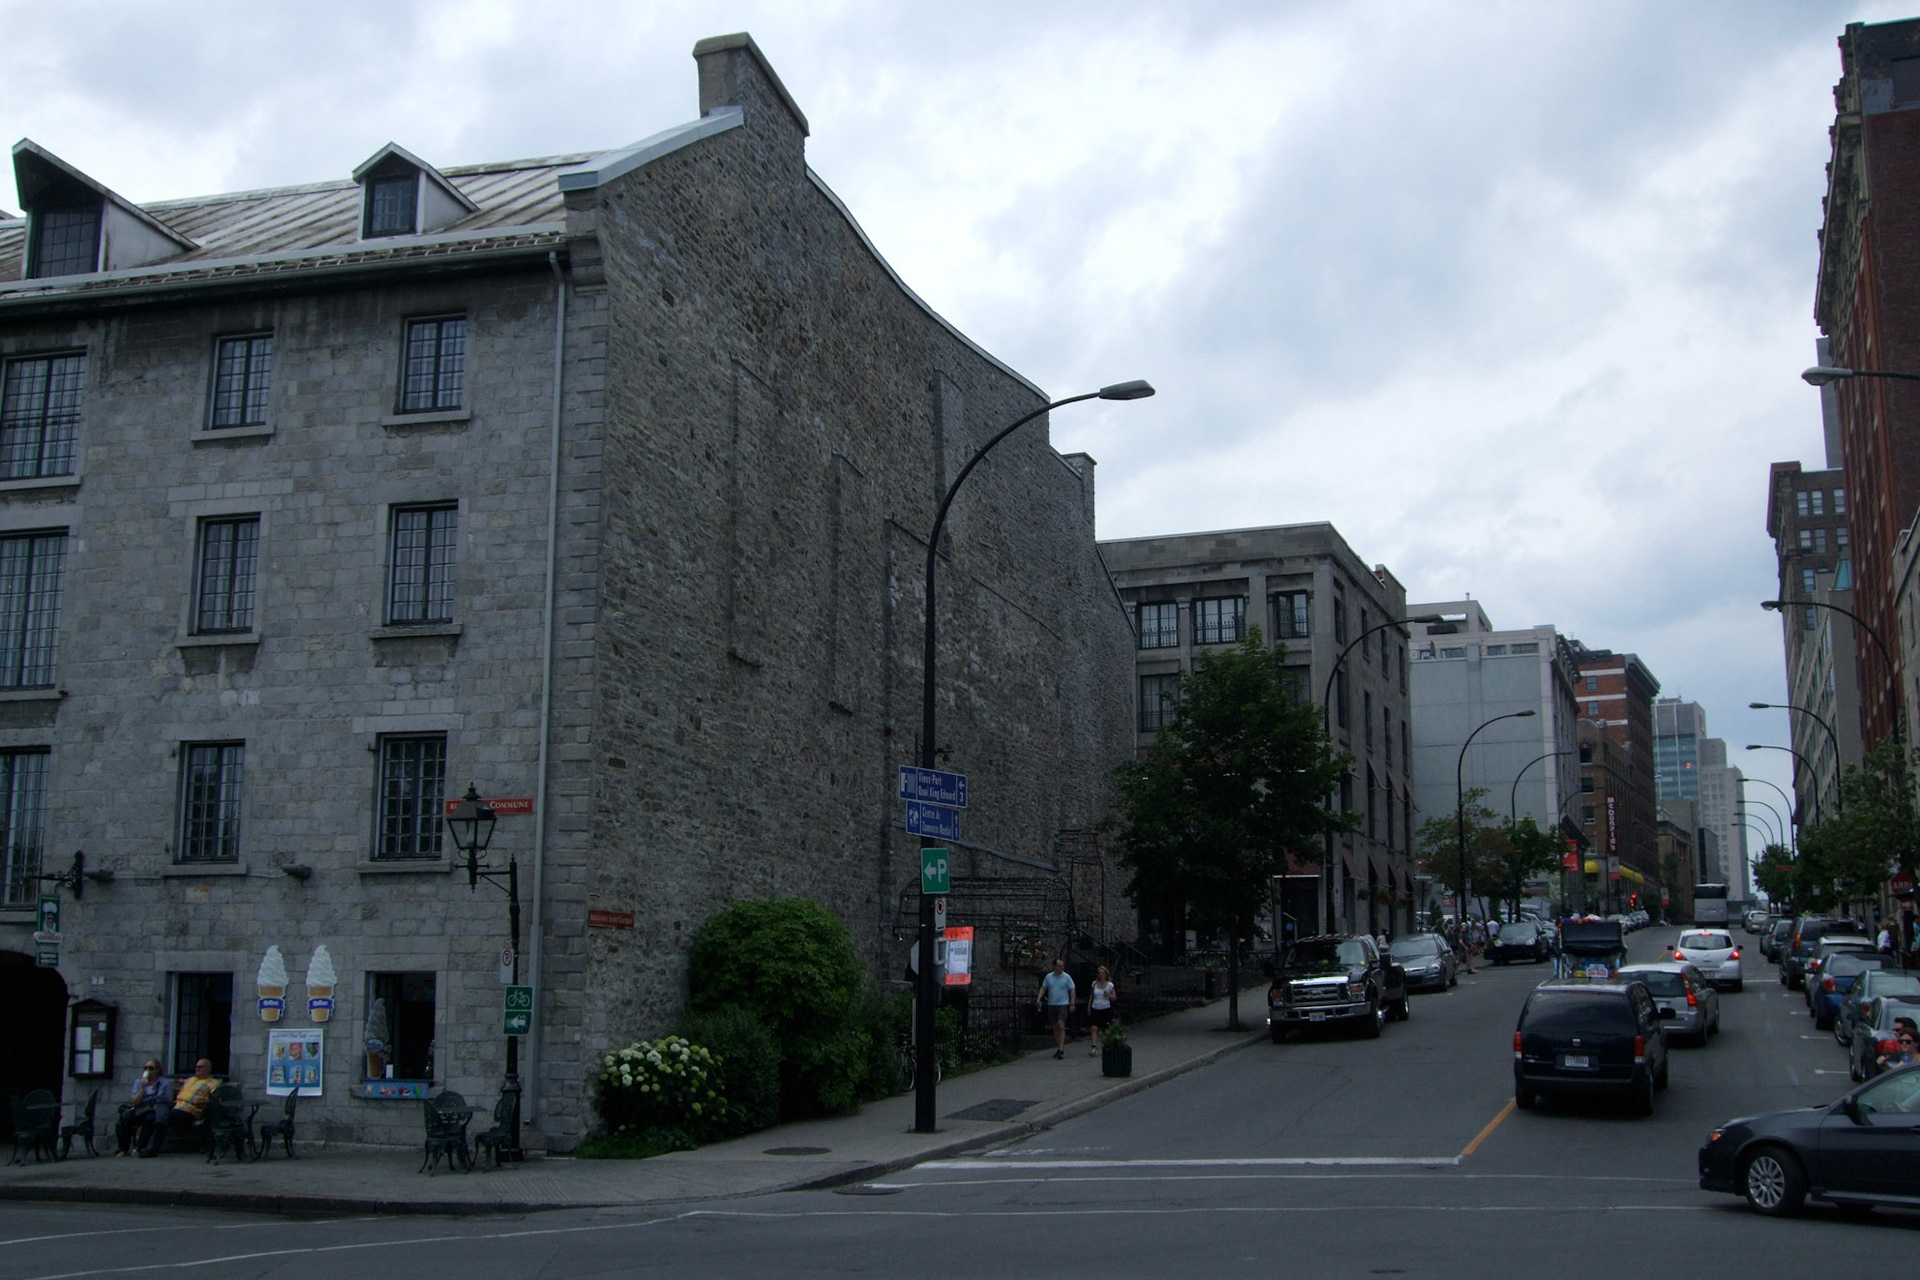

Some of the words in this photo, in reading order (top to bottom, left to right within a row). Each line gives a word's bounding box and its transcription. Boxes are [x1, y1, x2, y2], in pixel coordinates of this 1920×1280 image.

[918, 772, 942, 785] Vieux-Port
[918, 785, 929, 797] Quai
[930, 787, 940, 800] King
[941, 788, 956, 801] Edward
[959, 791, 965, 802] 3
[490, 801, 529, 810] COMMUNE
[937, 858, 947, 882] P
